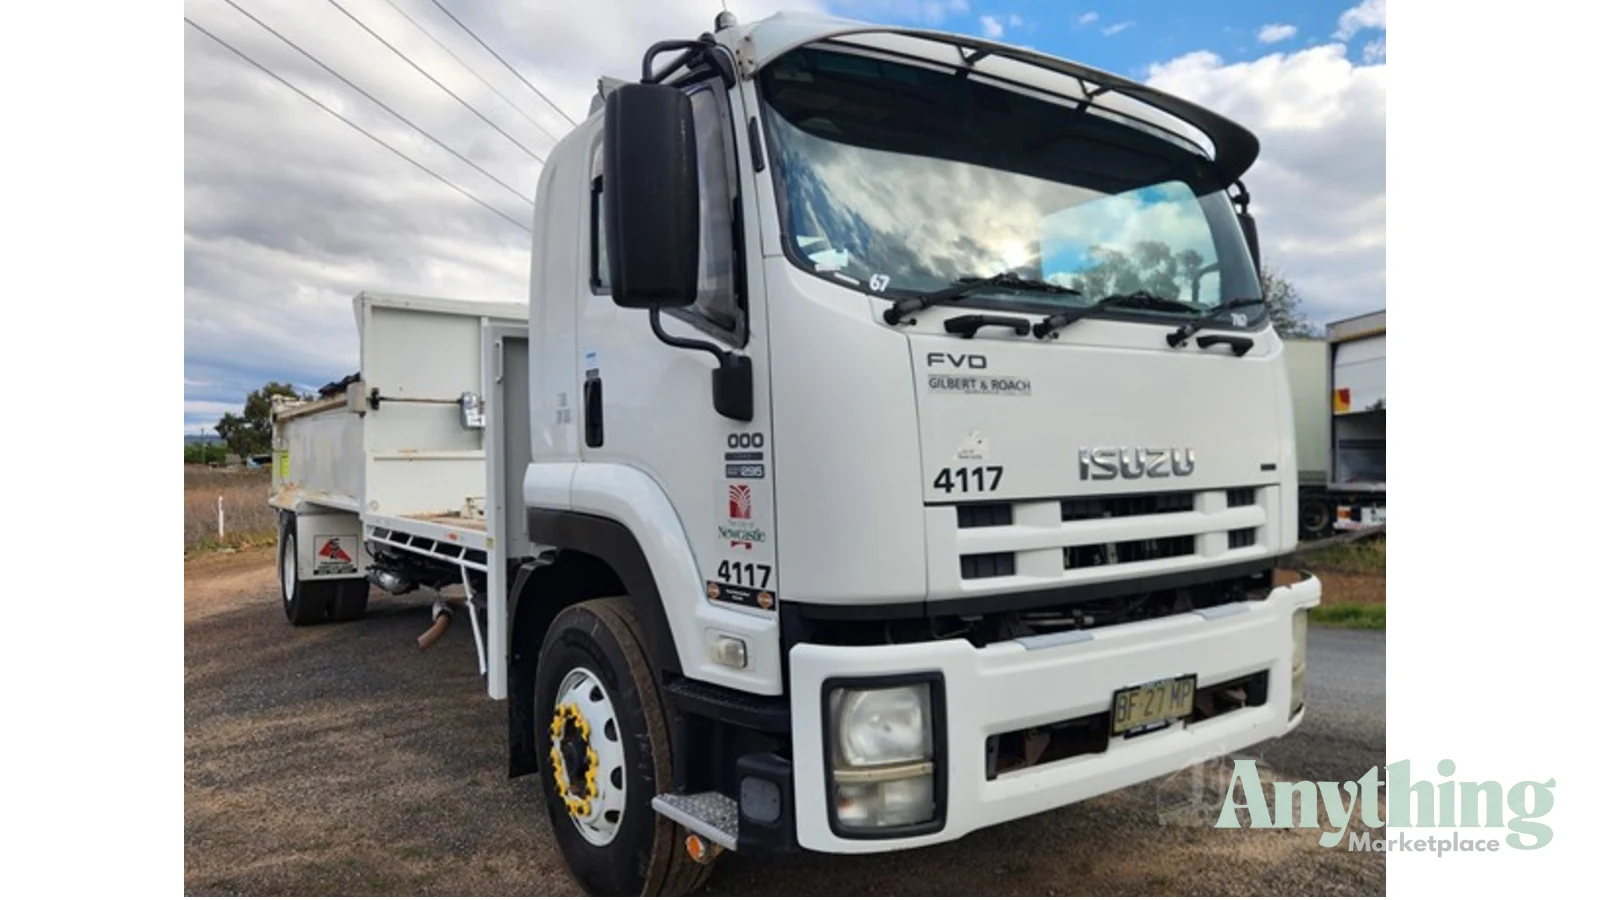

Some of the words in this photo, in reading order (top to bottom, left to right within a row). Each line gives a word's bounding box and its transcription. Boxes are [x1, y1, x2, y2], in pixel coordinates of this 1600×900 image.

[869, 273, 890, 292] 67
[928, 352, 987, 369] FVD
[929, 378, 976, 390] GILBERT
[991, 380, 1031, 391] ROACH
[1079, 448, 1195, 481] ISUZU
[933, 466, 1003, 493] 4117
[717, 525, 766, 543] Newcastle
[717, 560, 771, 588] 4117
[1117, 692, 1139, 722] BF
[1143, 689, 1166, 717] 27
[1170, 681, 1191, 709] MP
